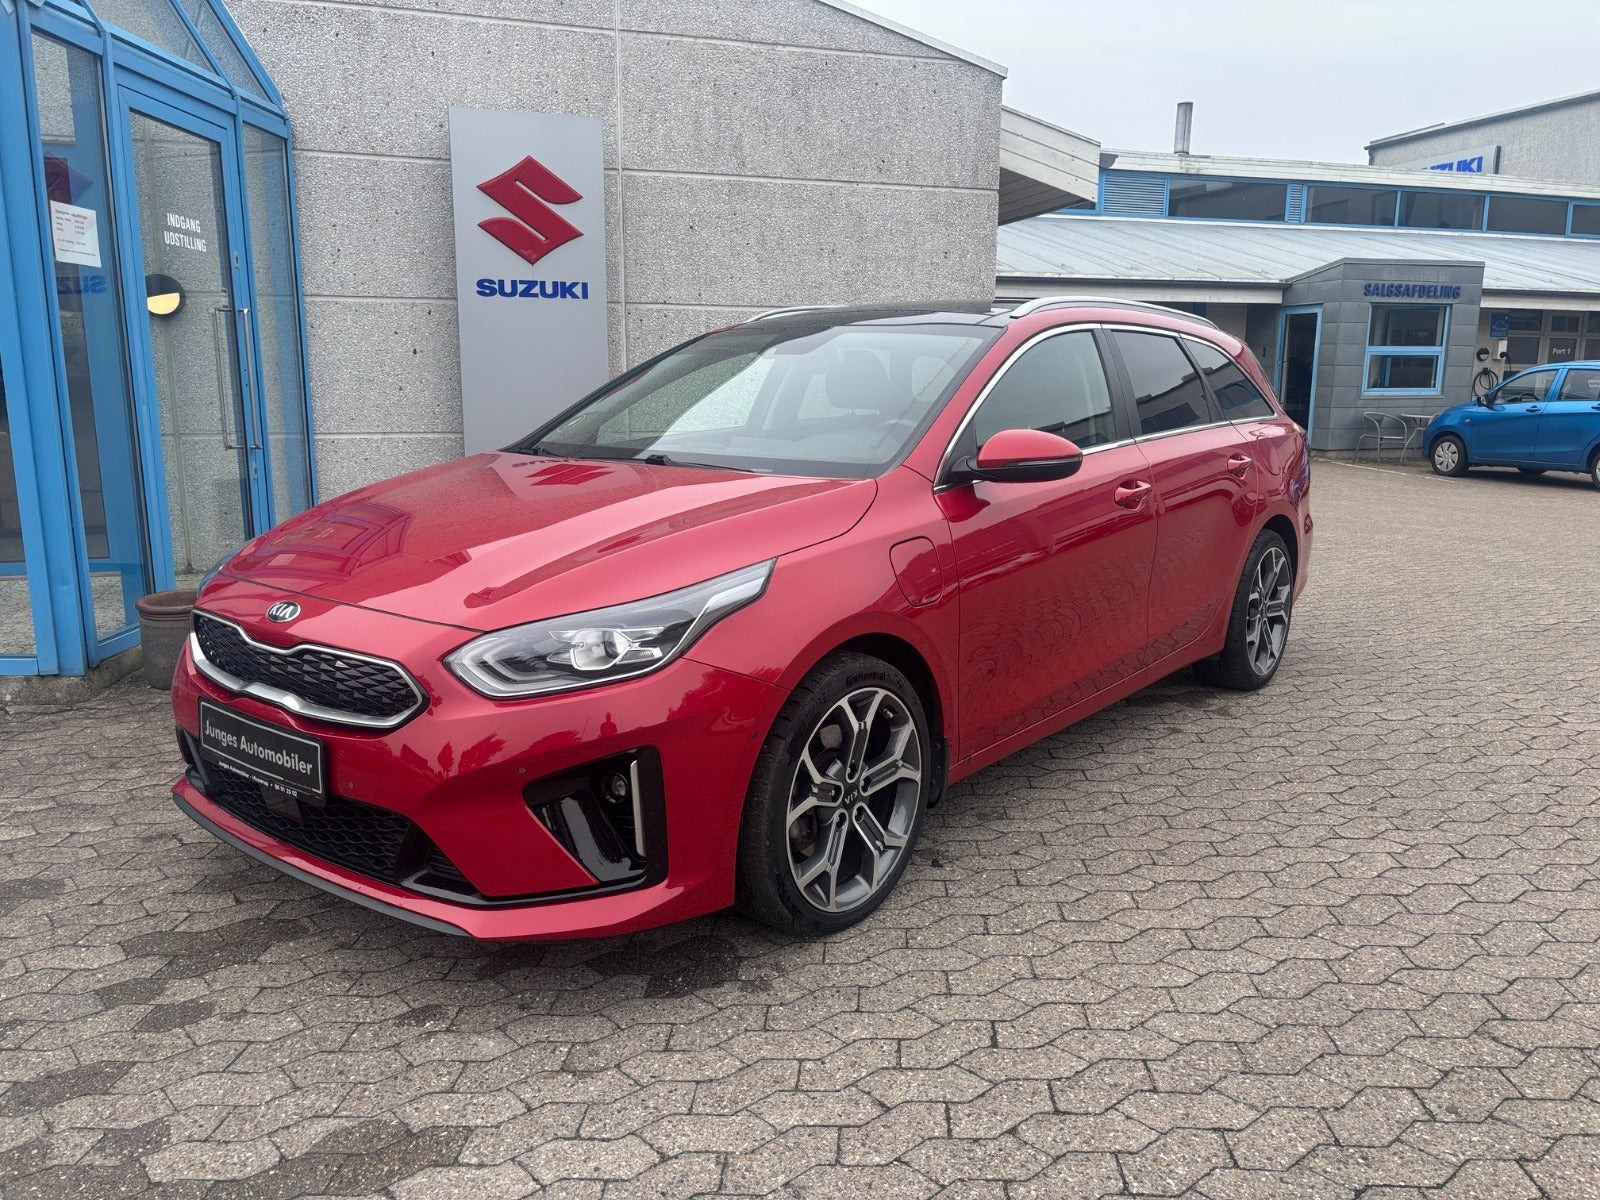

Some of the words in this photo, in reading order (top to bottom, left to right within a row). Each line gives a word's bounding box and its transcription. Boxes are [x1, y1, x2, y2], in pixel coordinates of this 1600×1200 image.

[166, 212, 201, 233] INDGANG
[164, 230, 207, 252] UDSTILLING
[476, 278, 589, 299] SUZUKI
[1363, 282, 1462, 299] SALGSAFDELING
[1552, 347, 1565, 355] Port
[268, 602, 297, 619] KIA
[205, 720, 238, 746] Junges
[240, 735, 313, 775] Automobiler
[844, 789, 858, 805] KIA
